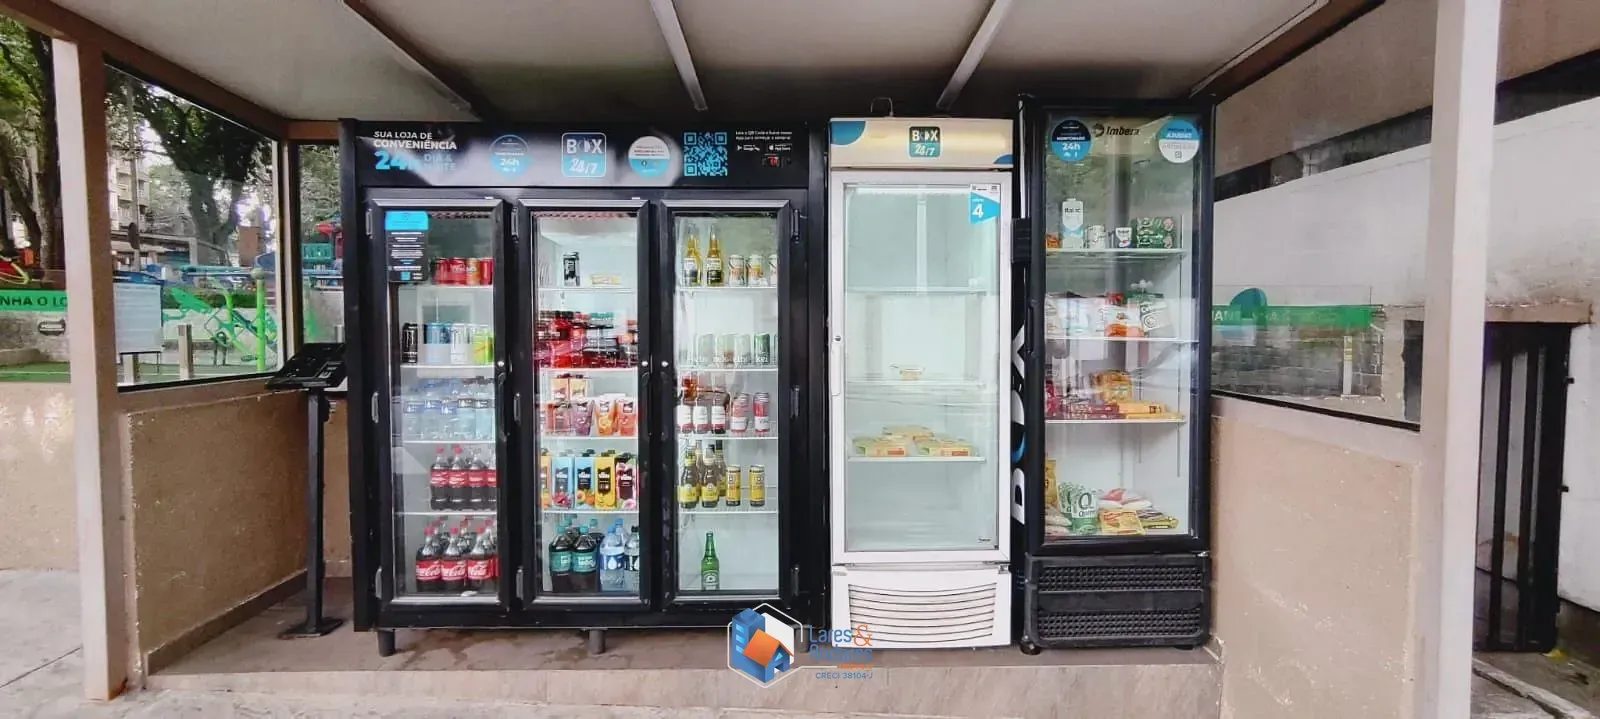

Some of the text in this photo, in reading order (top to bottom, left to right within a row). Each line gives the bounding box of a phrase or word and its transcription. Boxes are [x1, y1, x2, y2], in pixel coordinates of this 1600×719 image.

[395, 131, 417, 139] LOJA
[420, 132, 433, 140] DE
[373, 138, 458, 150] CONVENIÊNCIA
[972, 203, 985, 218] 4
[37, 296, 48, 306] O
